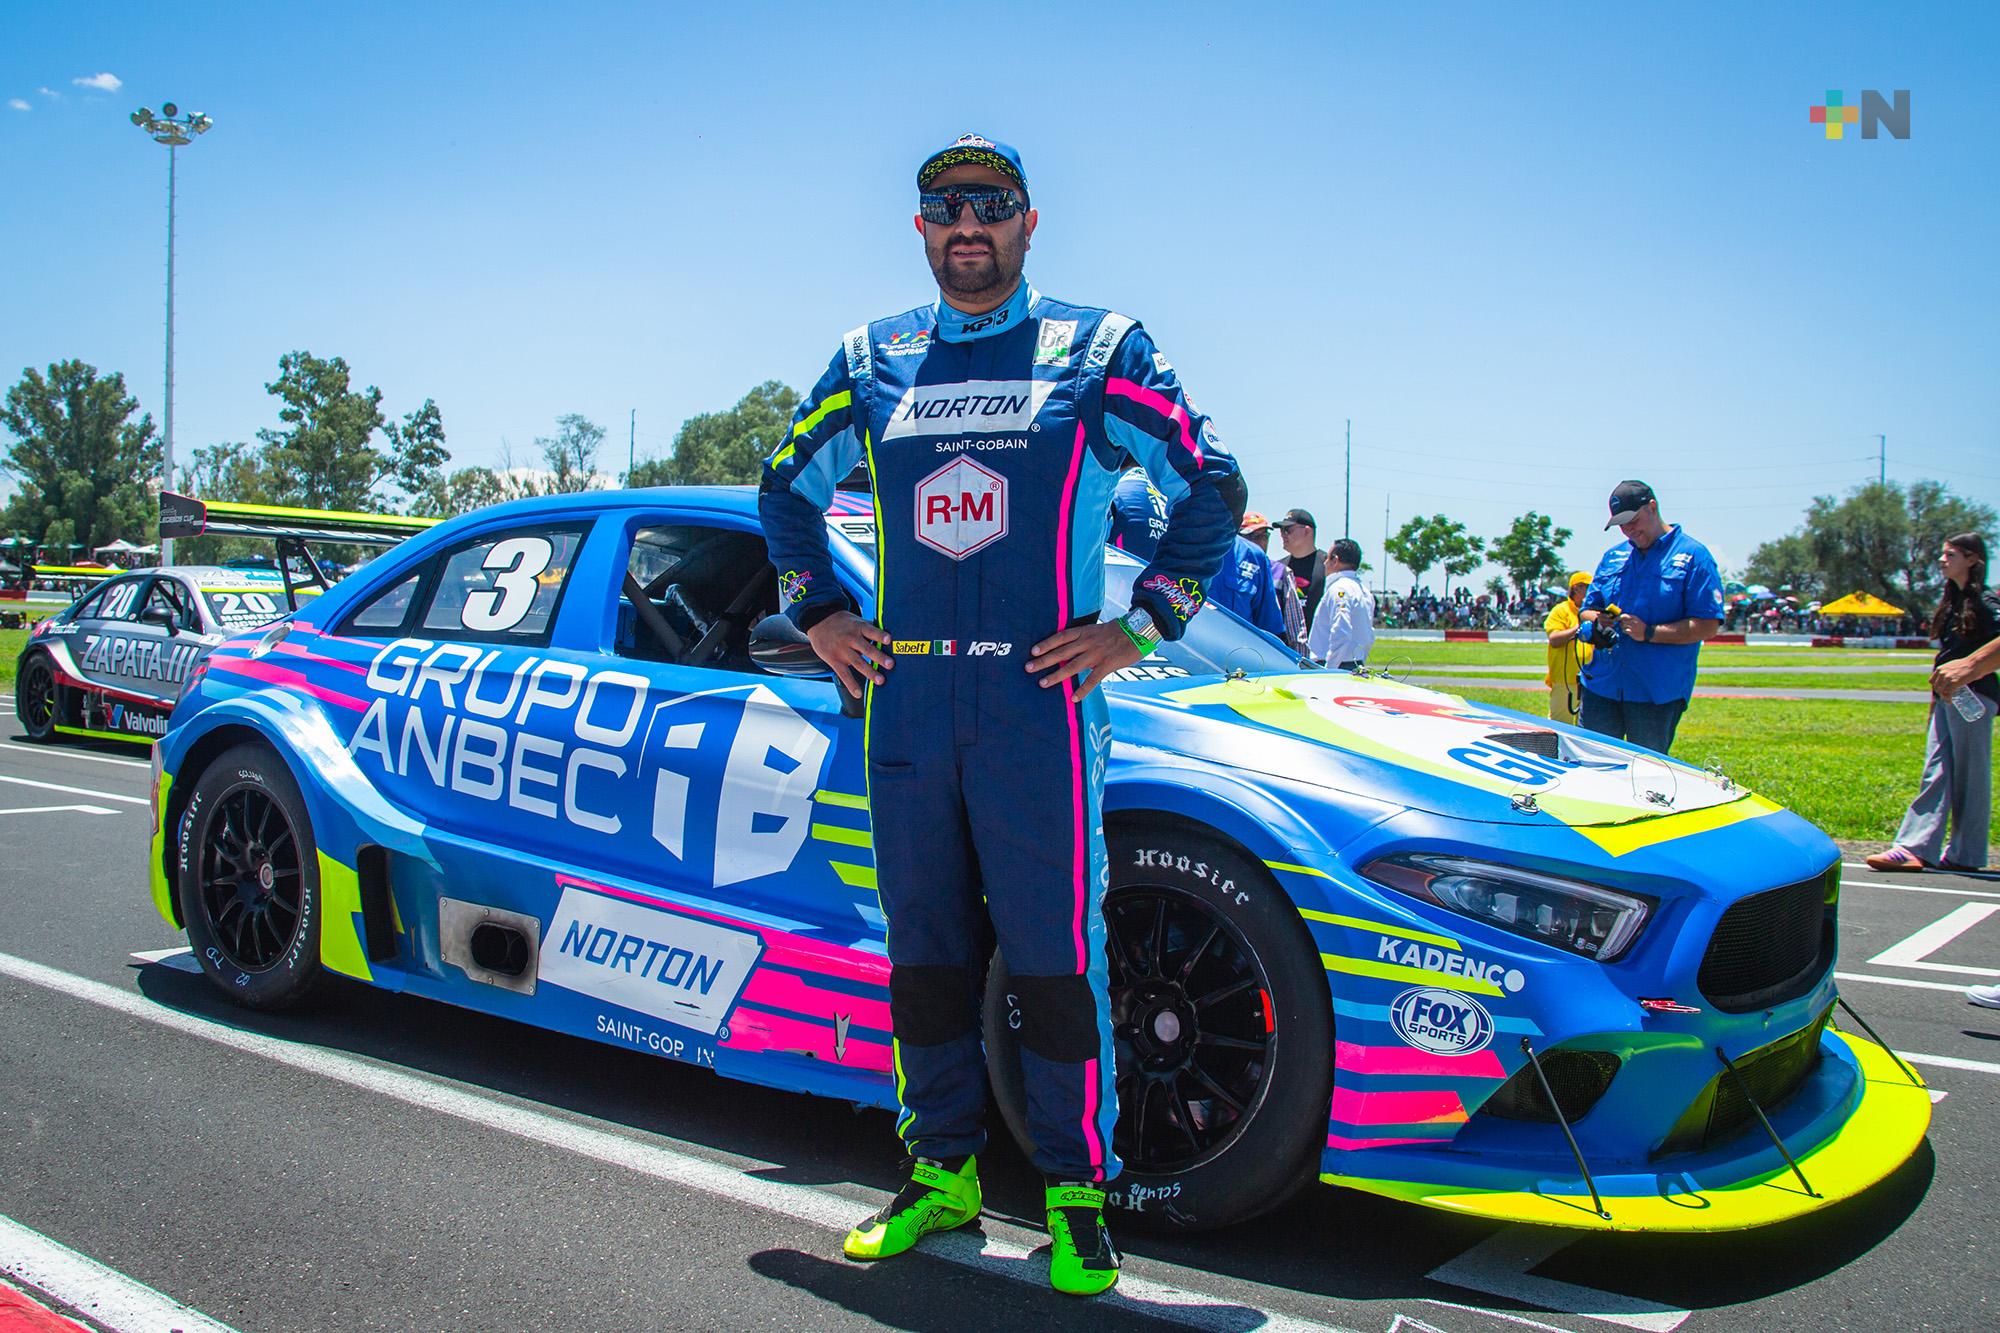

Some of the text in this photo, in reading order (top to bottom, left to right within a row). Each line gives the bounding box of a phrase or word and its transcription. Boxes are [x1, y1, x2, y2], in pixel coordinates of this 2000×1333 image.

[1095, 326, 1117, 360] Sbelt
[903, 395, 1029, 421] NORTON
[935, 439, 1028, 452] SAINT-GOBAIN
[926, 492, 994, 525] R-M
[1148, 517, 1168, 531] GRU
[102, 583, 139, 618] 20
[461, 537, 554, 631] 3
[212, 593, 278, 615] 20
[81, 634, 164, 681] ZAPATA
[895, 642, 927, 654] Sabelt
[366, 637, 650, 748] GRUPO
[349, 698, 628, 835] ANBEC
[1134, 848, 1250, 906] Hoosier
[560, 919, 724, 996] NORTON
[1412, 996, 1472, 1036] FOX
[1408, 1021, 1467, 1047] SPORTS
